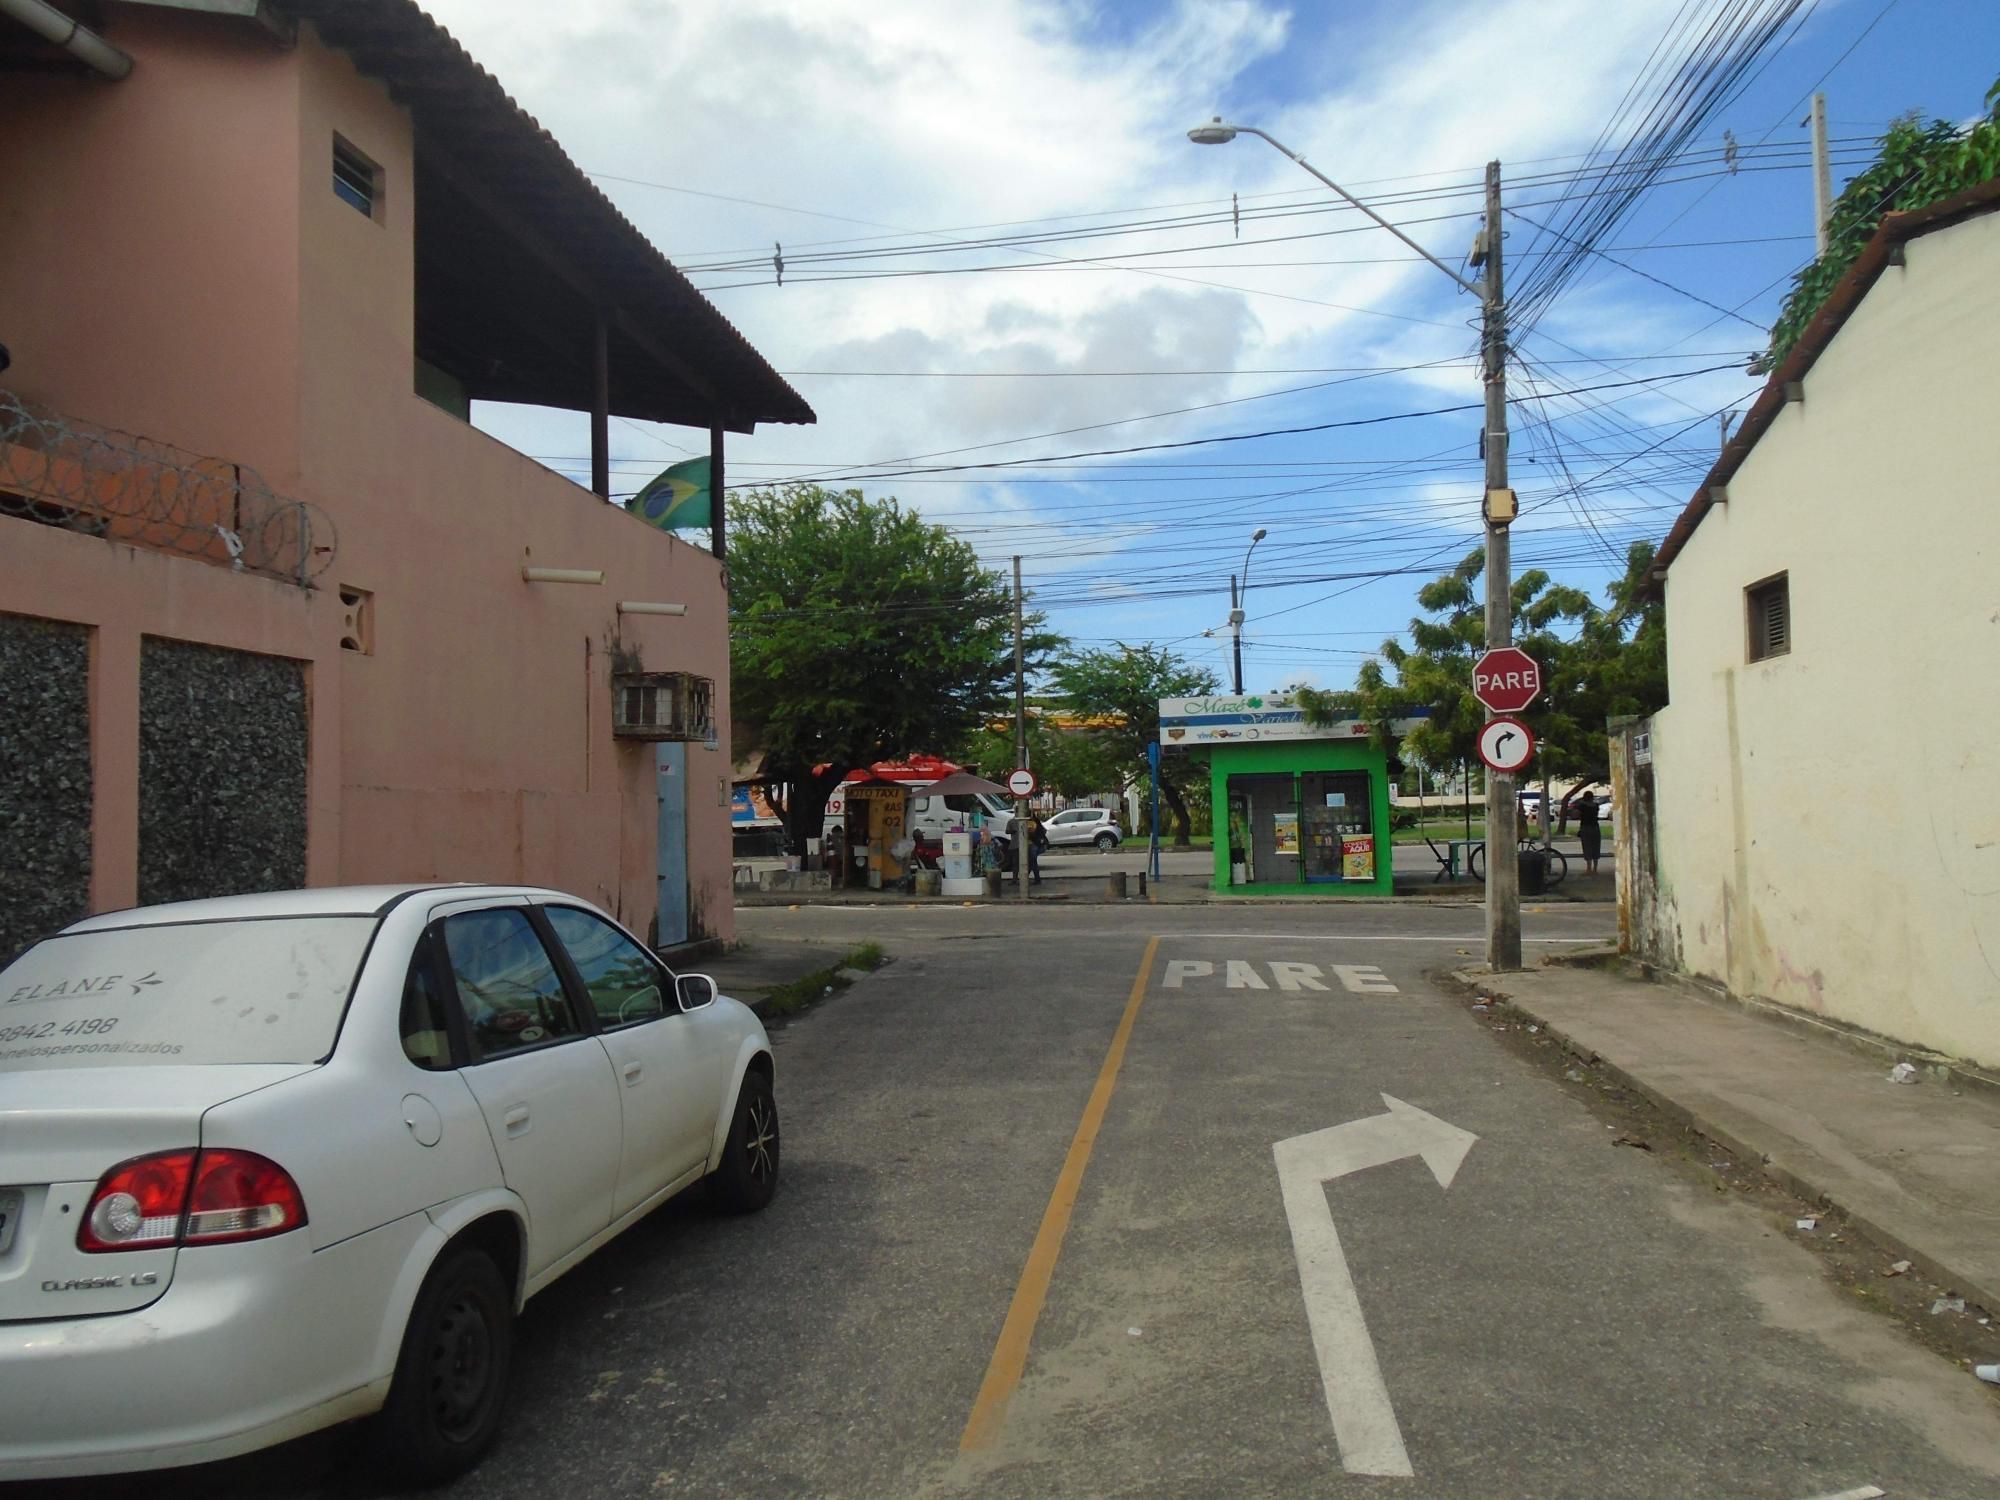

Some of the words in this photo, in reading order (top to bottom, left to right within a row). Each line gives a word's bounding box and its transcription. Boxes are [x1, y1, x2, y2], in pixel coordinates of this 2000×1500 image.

[1476, 671, 1536, 692] PARE
[875, 788, 899, 798] TAXI
[826, 801, 844, 814] 19
[1162, 960, 1399, 992] PARE
[7, 975, 123, 1003] ELANE
[42, 1275, 122, 1292] CLASSIC
[131, 1272, 158, 1286] LS
